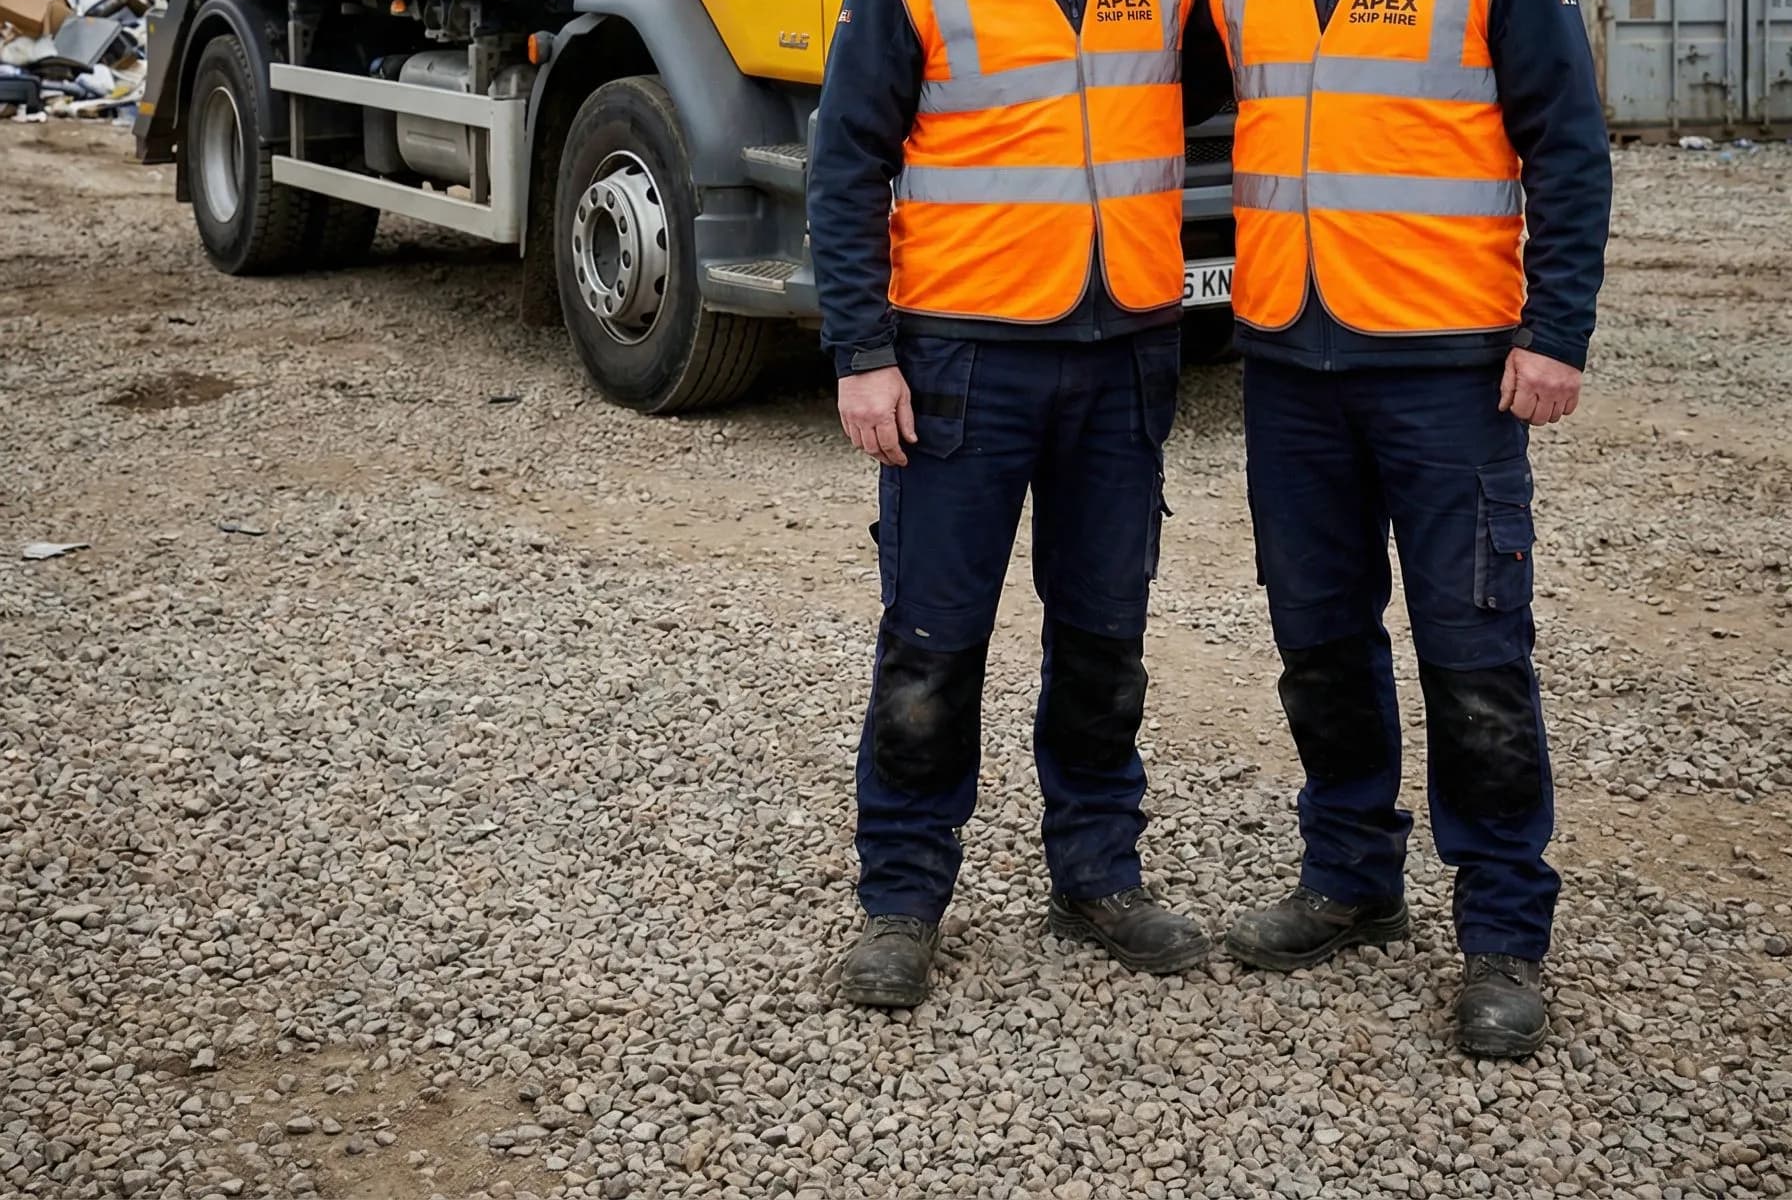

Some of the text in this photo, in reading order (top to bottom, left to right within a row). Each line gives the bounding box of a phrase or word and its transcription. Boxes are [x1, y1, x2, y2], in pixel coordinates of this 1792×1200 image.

[1097, 10, 1153, 22] SKIP HIRE
[1349, 12, 1417, 26] SKIP HIRE
